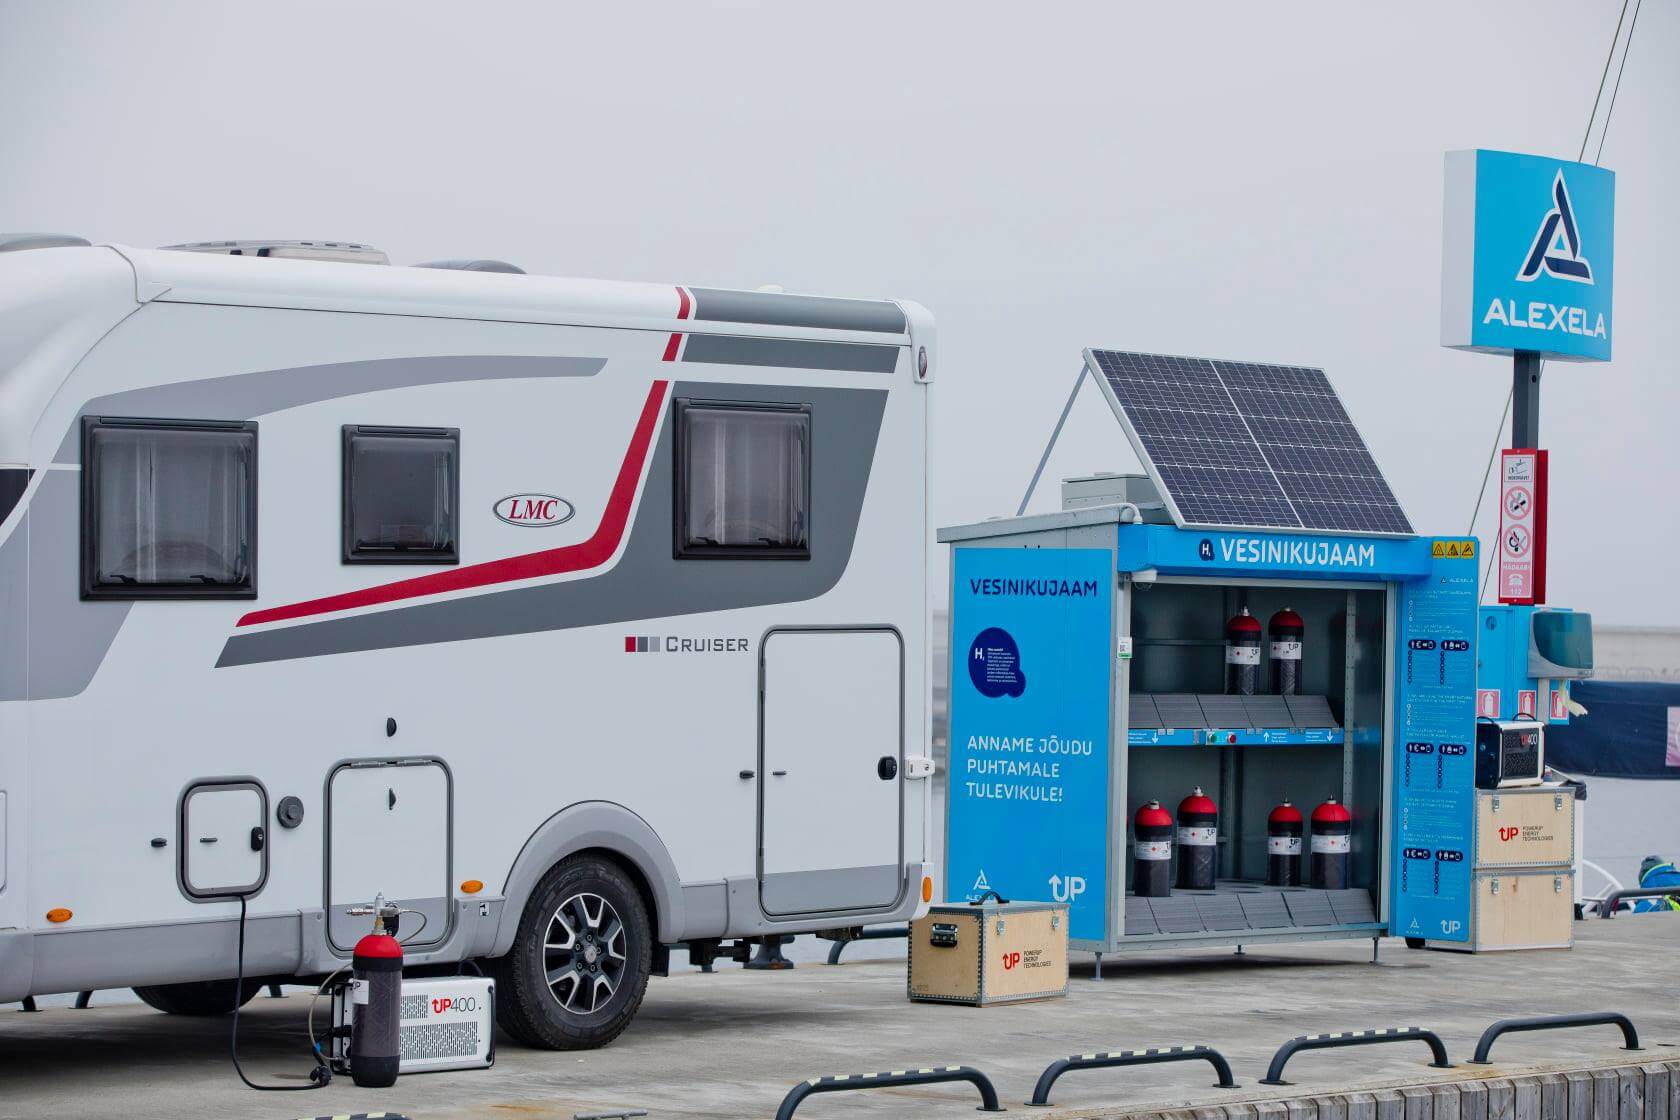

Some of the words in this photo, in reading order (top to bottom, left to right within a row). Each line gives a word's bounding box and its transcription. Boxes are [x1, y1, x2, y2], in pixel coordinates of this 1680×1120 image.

[1483, 298, 1607, 340] ALEXELA
[508, 499, 558, 520] LMC
[1220, 538, 1375, 567] VESINIKUJAAM
[970, 578, 1097, 597] VESINIKUJAAM
[967, 736, 1034, 753] ANNAME
[1039, 735, 1093, 756] JÕUDU
[967, 759, 1060, 778] PUHTAMALE
[966, 782, 1063, 802] TULEVIKULE!
[1498, 827, 1519, 841] UP
[1048, 874, 1086, 902] UP
[1440, 919, 1461, 934] UP
[1002, 953, 1020, 969] UP
[432, 997, 476, 1014] UP400
